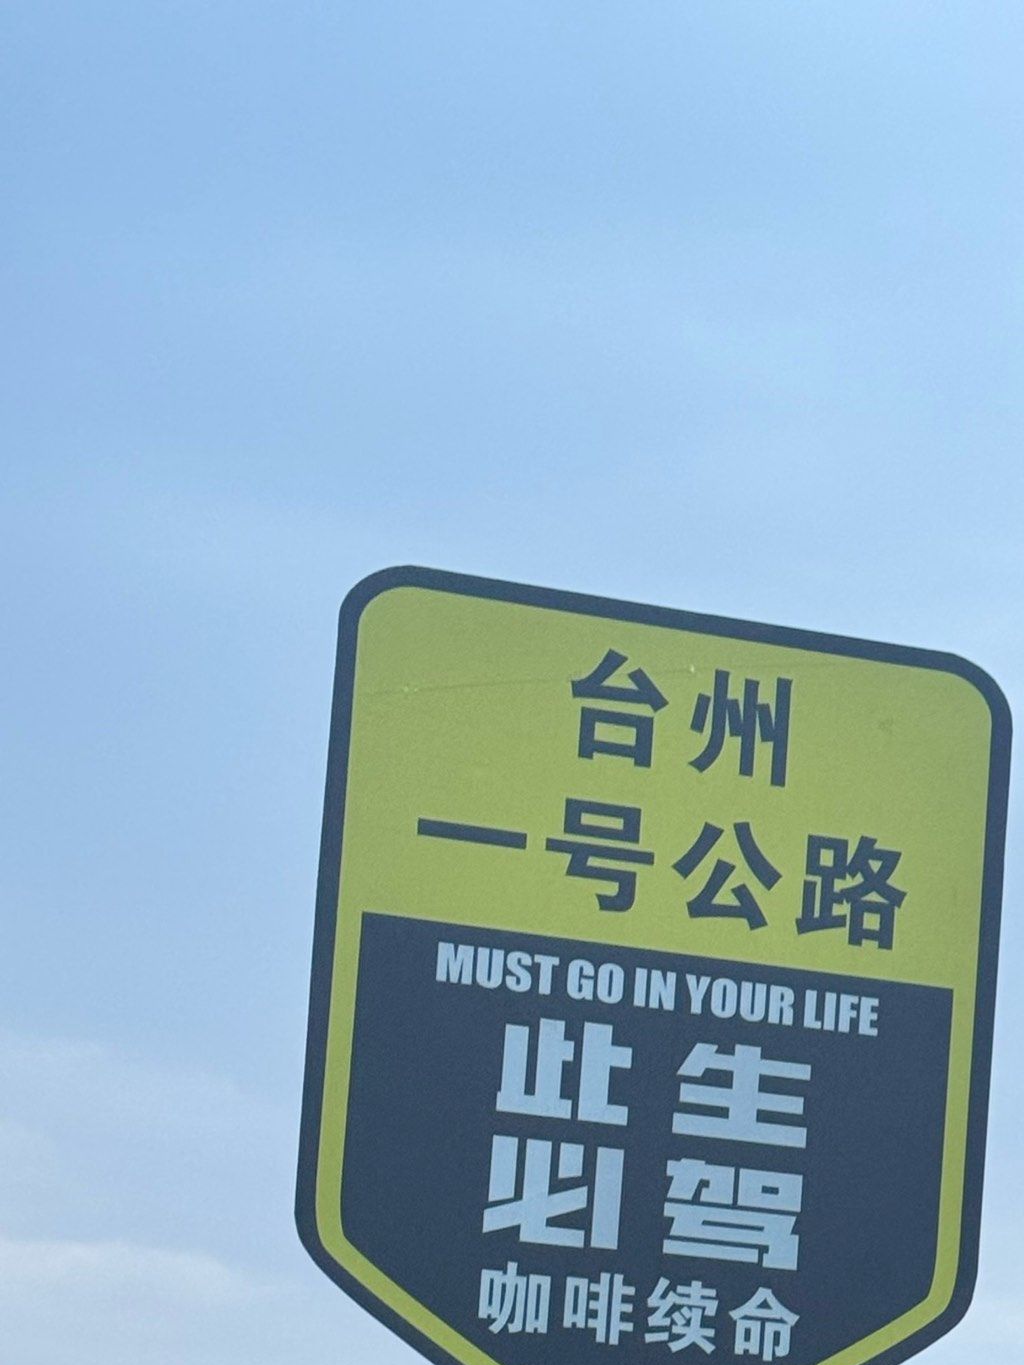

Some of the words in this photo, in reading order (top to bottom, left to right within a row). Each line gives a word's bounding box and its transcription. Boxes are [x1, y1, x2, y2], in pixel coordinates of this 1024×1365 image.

[570, 649, 793, 787] 台州
[417, 797, 907, 950] 一号公路
[435, 941, 560, 996] MUST
[566, 958, 625, 1004] GO
[633, 967, 677, 1011] IN
[686, 973, 795, 1027] YOUR
[803, 989, 880, 1037] LIFE
[495, 1020, 811, 1149] 此生
[482, 1134, 802, 1271] 必驾
[477, 1262, 800, 1361] 咖啡续命
